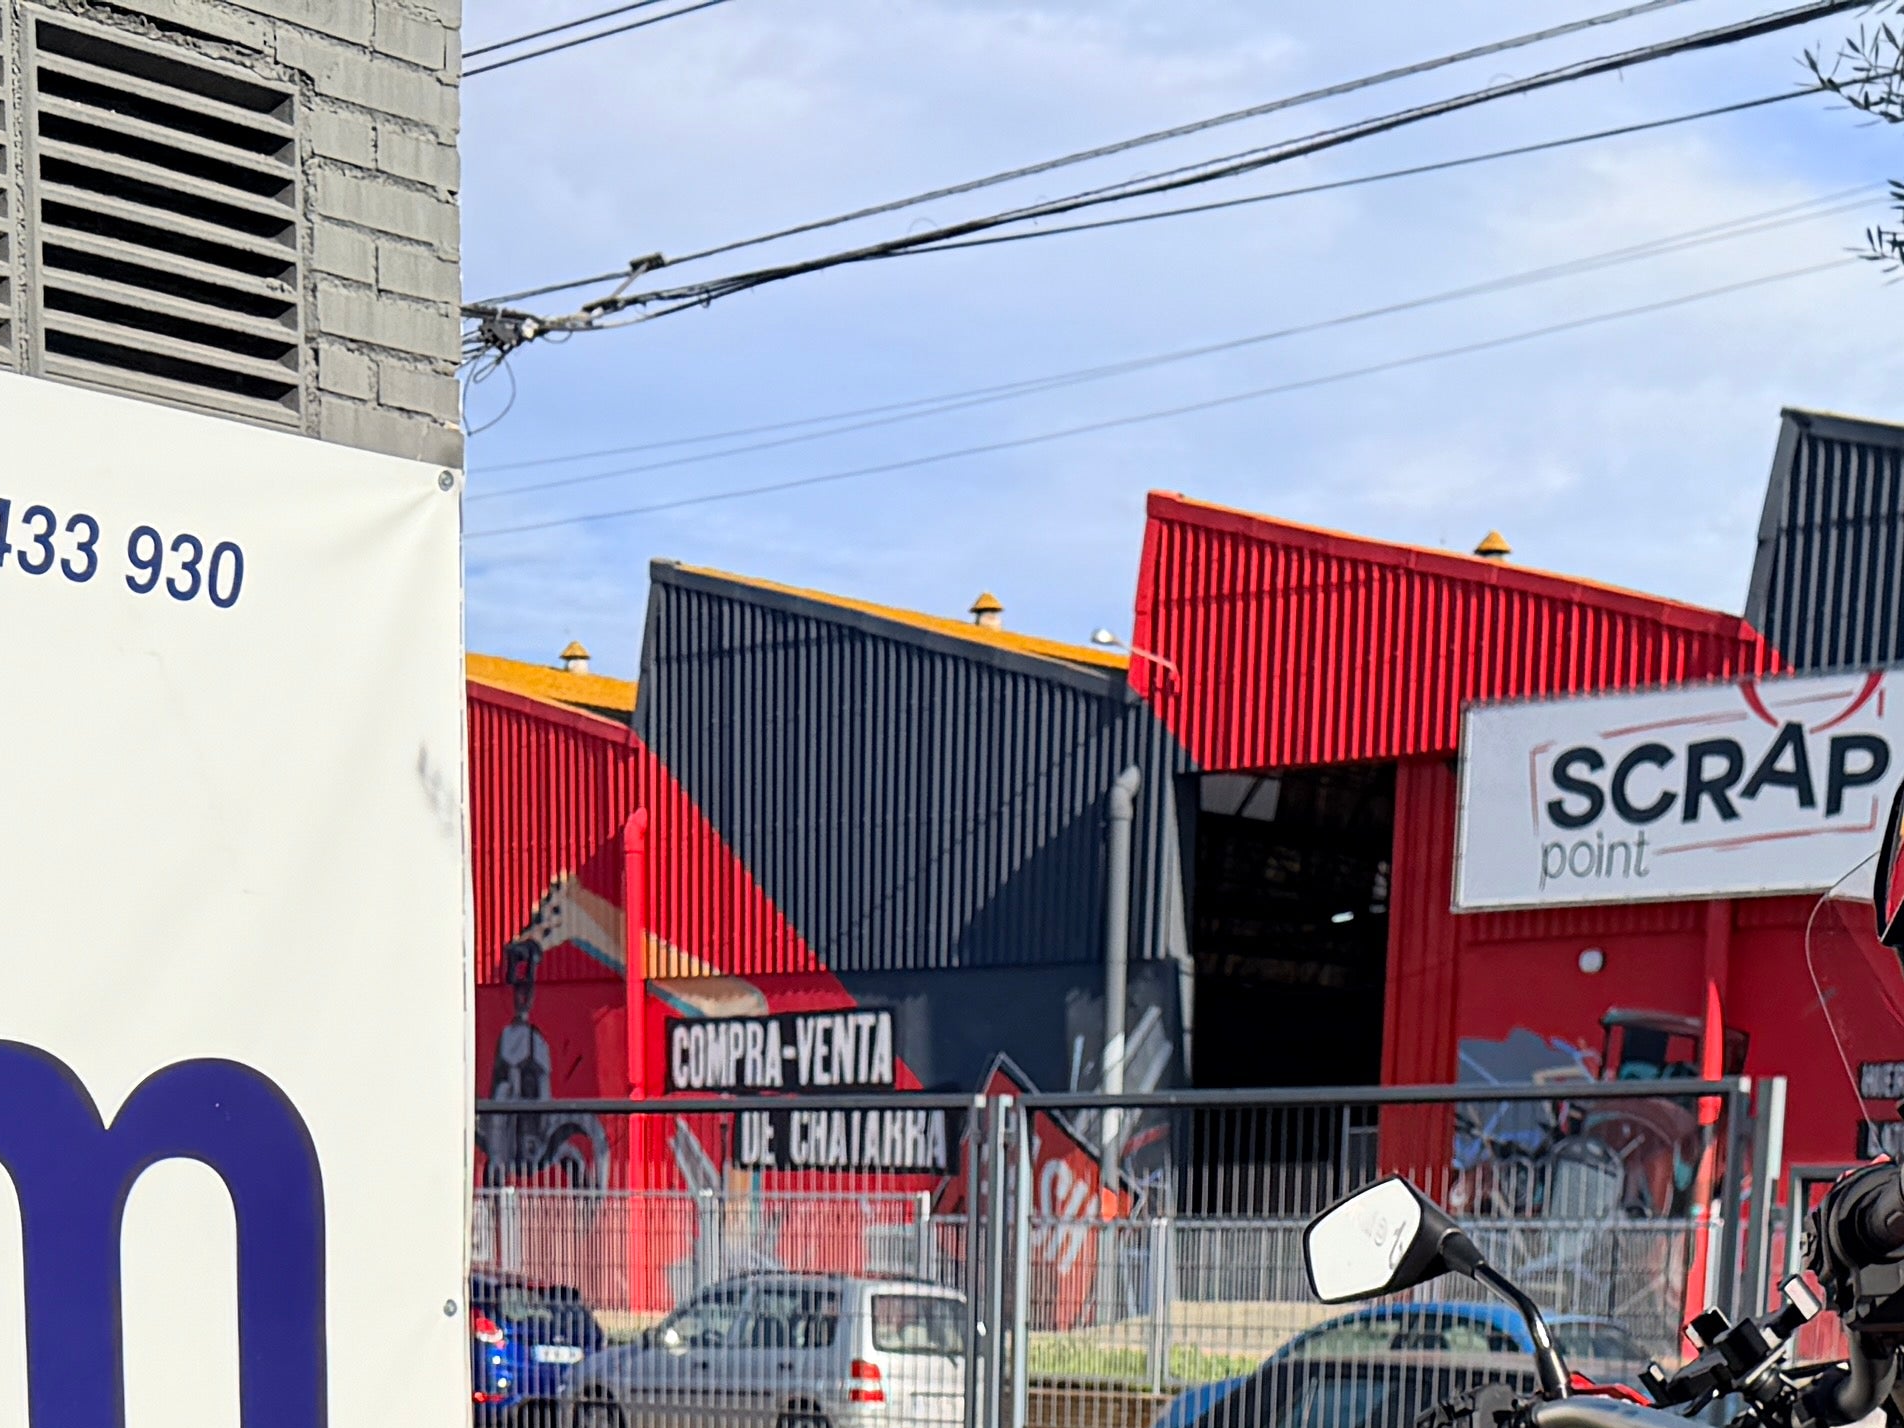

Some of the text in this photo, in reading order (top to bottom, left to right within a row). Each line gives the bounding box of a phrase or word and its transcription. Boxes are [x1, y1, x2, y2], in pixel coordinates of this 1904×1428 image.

[125, 524, 245, 609] 930
[1547, 722, 1891, 830] SCRAP
[1539, 829, 1651, 889] point
[672, 1011, 894, 1089] COMPRA-VENTA
[741, 1108, 947, 1168] DE CHATARRA
